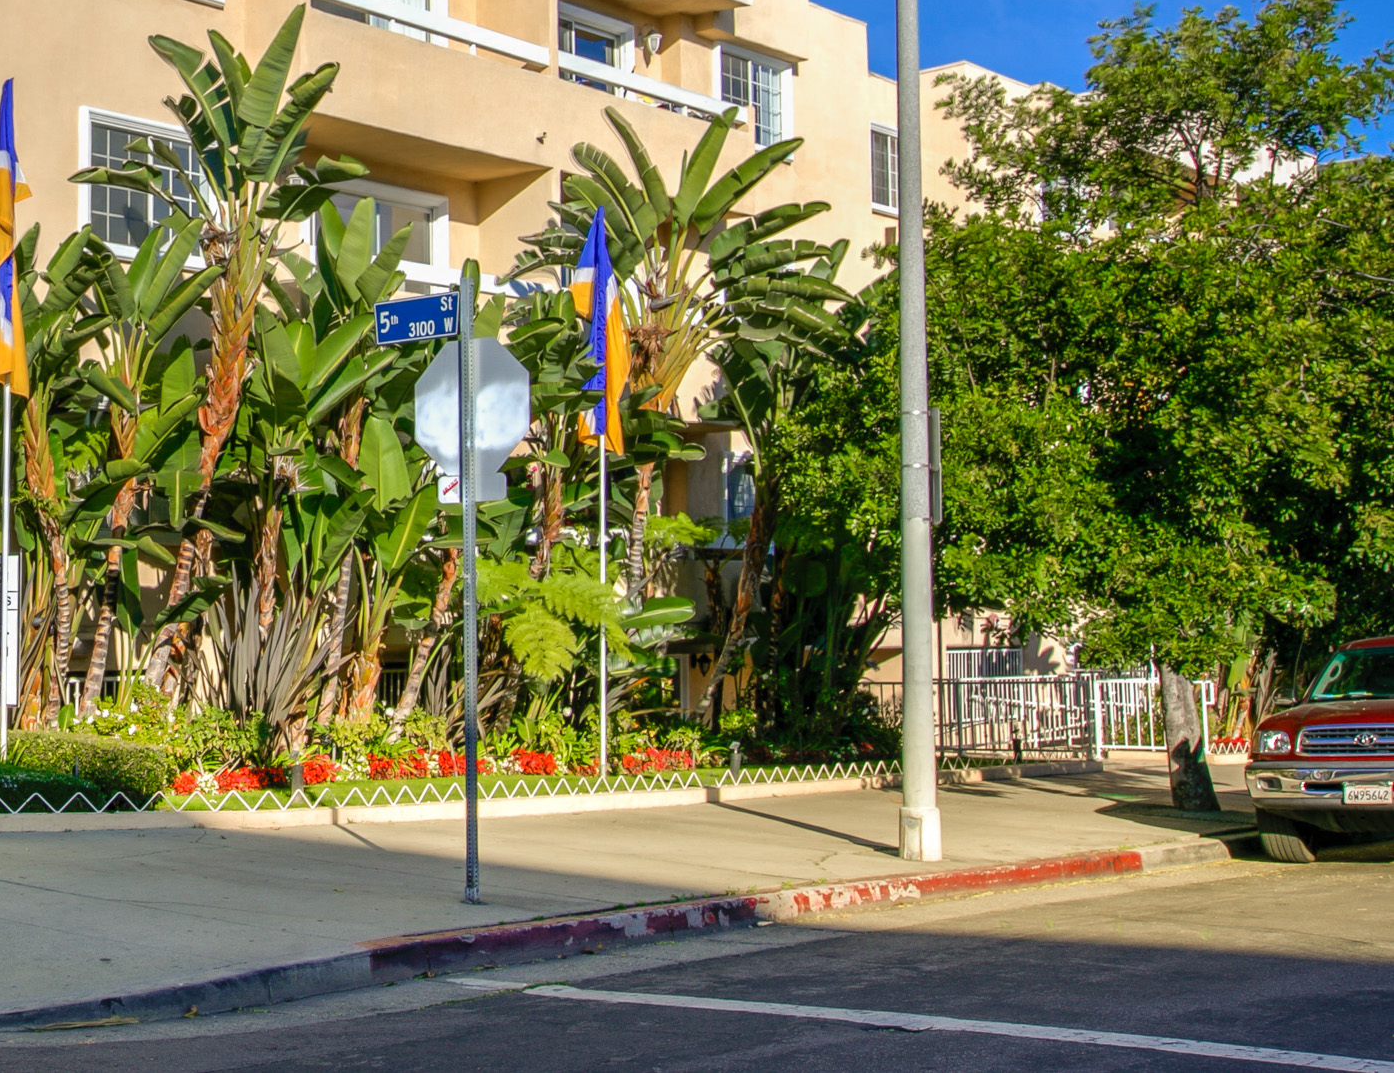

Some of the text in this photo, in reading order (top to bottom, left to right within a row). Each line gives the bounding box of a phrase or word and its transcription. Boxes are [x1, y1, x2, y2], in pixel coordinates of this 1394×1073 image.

[379, 296, 453, 334] 5th St
[408, 316, 454, 338] 3100 W
